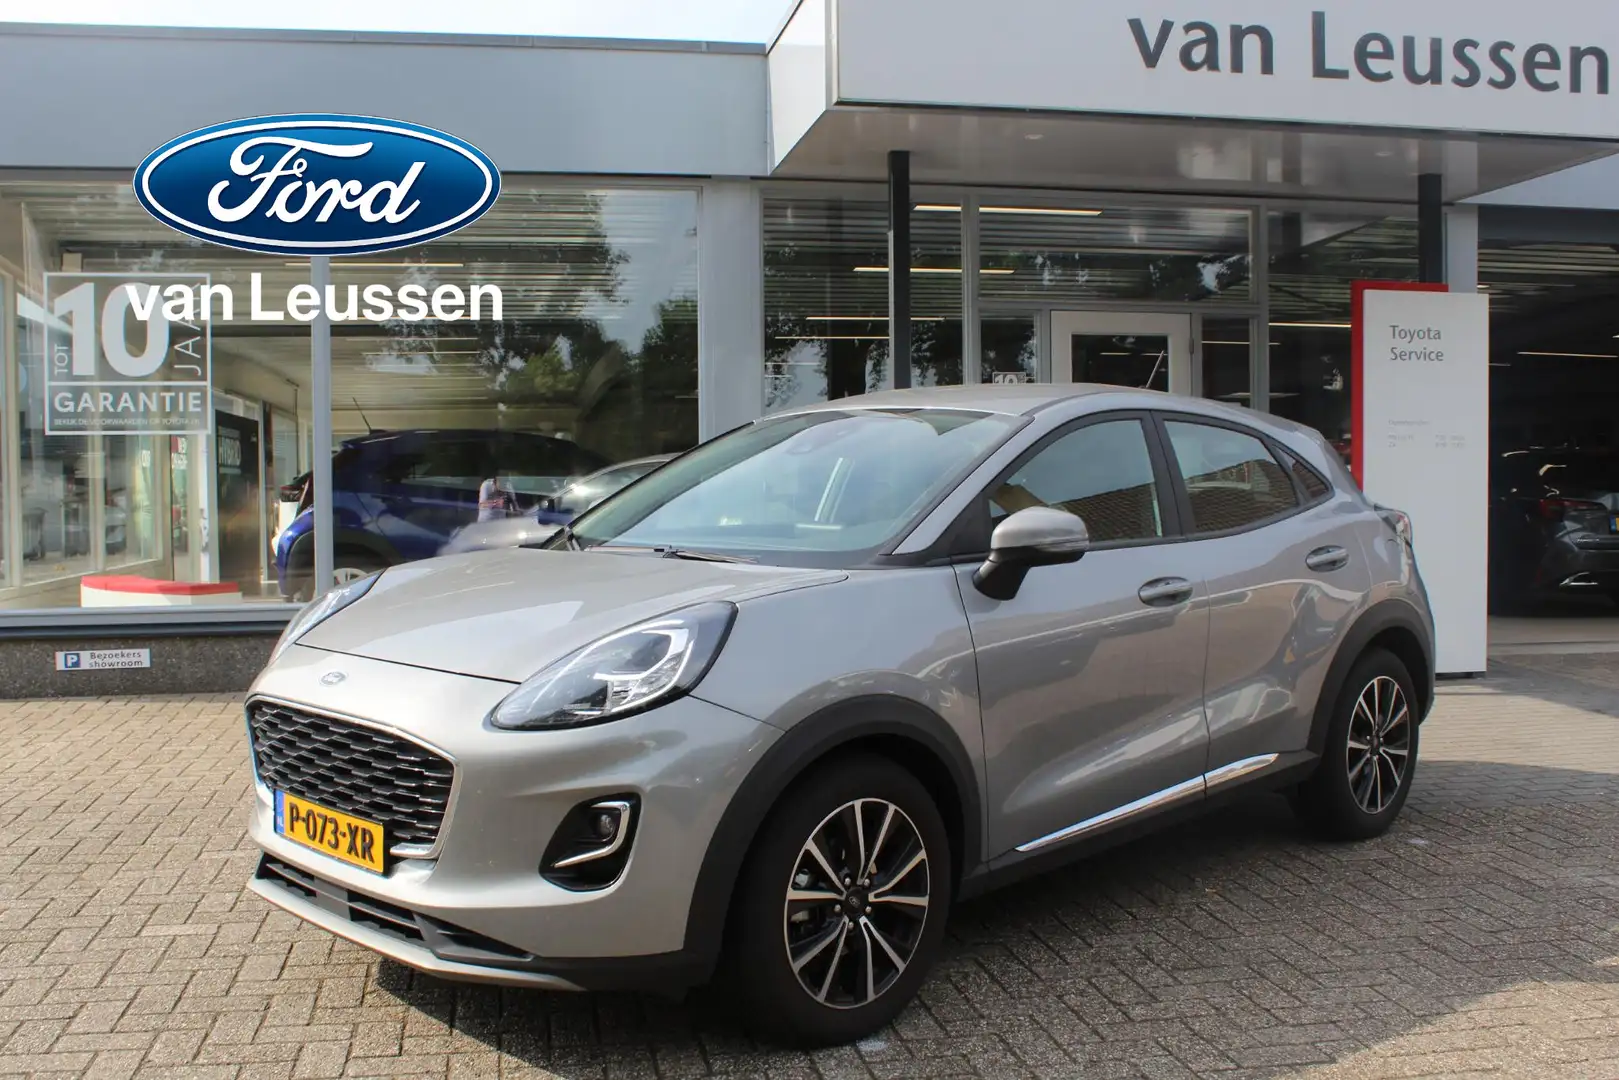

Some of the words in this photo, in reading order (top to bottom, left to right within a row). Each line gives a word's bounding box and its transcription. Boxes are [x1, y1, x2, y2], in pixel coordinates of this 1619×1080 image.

[1127, 18, 1274, 75] van
[1311, 11, 1609, 95] Leussen
[54, 282, 170, 377] 10
[1389, 325, 1441, 343] Toyota
[54, 344, 69, 376] TOT
[1390, 347, 1444, 361] Service
[54, 392, 202, 413] GARANTIE
[89, 660, 143, 668] showroom
[90, 651, 142, 661] Bezoekers
[289, 802, 375, 863] P-073-XR
